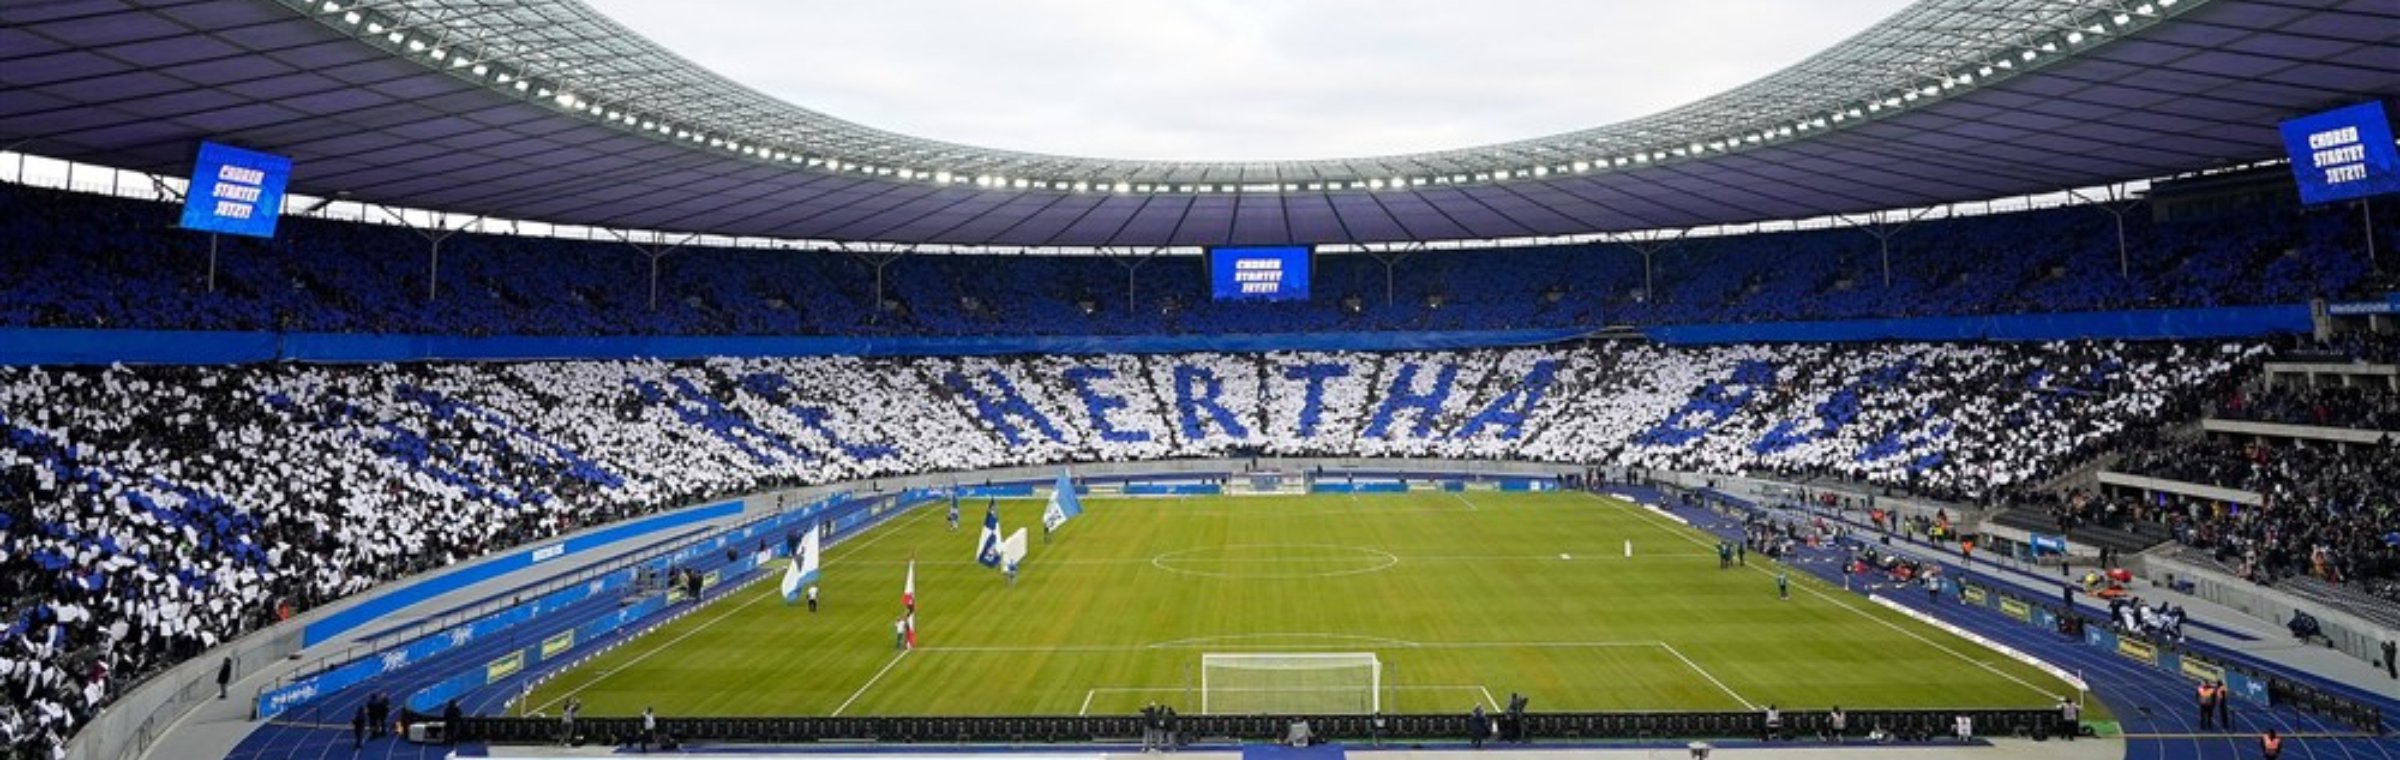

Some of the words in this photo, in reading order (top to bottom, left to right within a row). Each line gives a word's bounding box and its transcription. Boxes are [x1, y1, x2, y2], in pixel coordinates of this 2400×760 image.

[2308, 126, 2358, 150] CHOREO
[2313, 143, 2365, 168] STARTET
[2325, 162, 2367, 185] JETZT!
[212, 181, 262, 203] STARTET
[944, 358, 1561, 446] HERTHA
